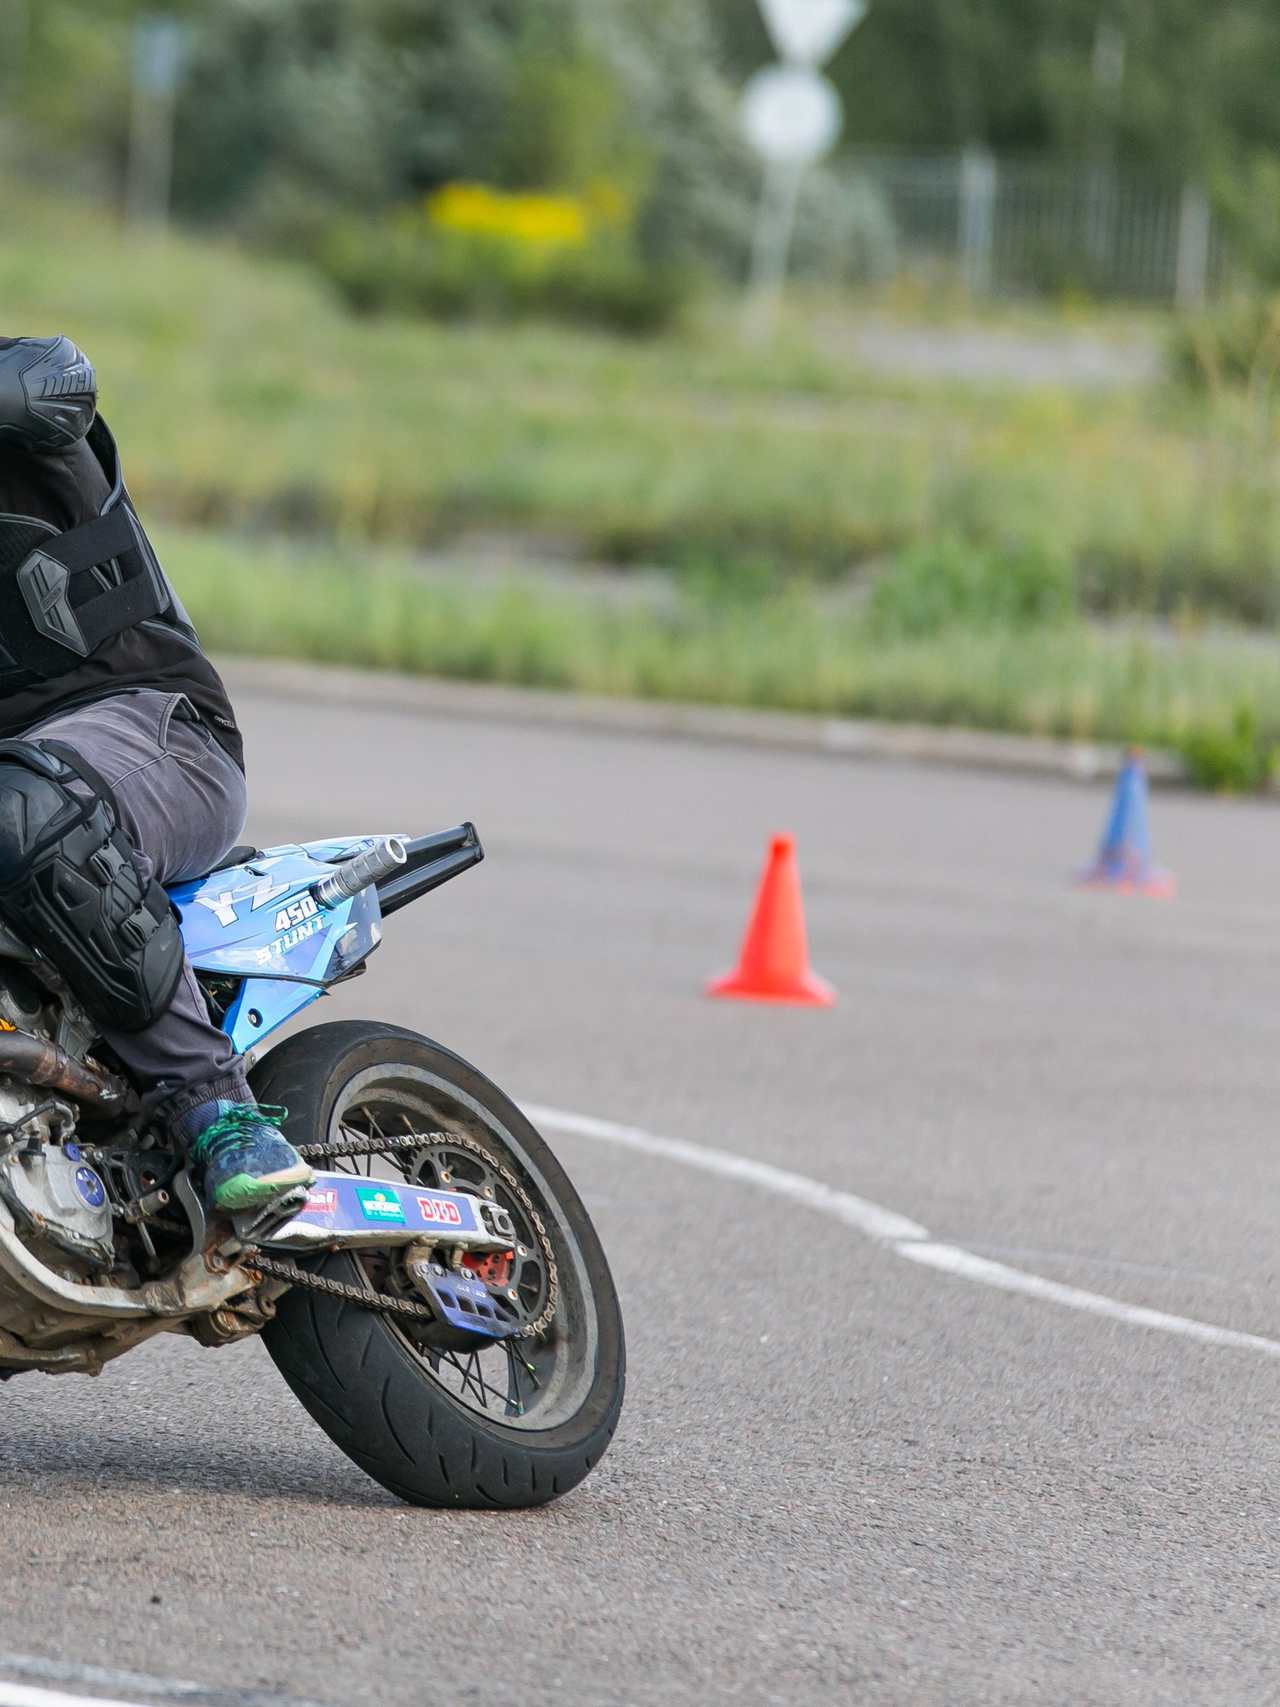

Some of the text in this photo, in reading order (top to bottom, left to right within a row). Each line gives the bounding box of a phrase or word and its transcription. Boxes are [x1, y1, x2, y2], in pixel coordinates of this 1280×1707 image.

[194, 875, 291, 928] YZ
[275, 895, 319, 932] 450
[256, 914, 325, 967] STUNT
